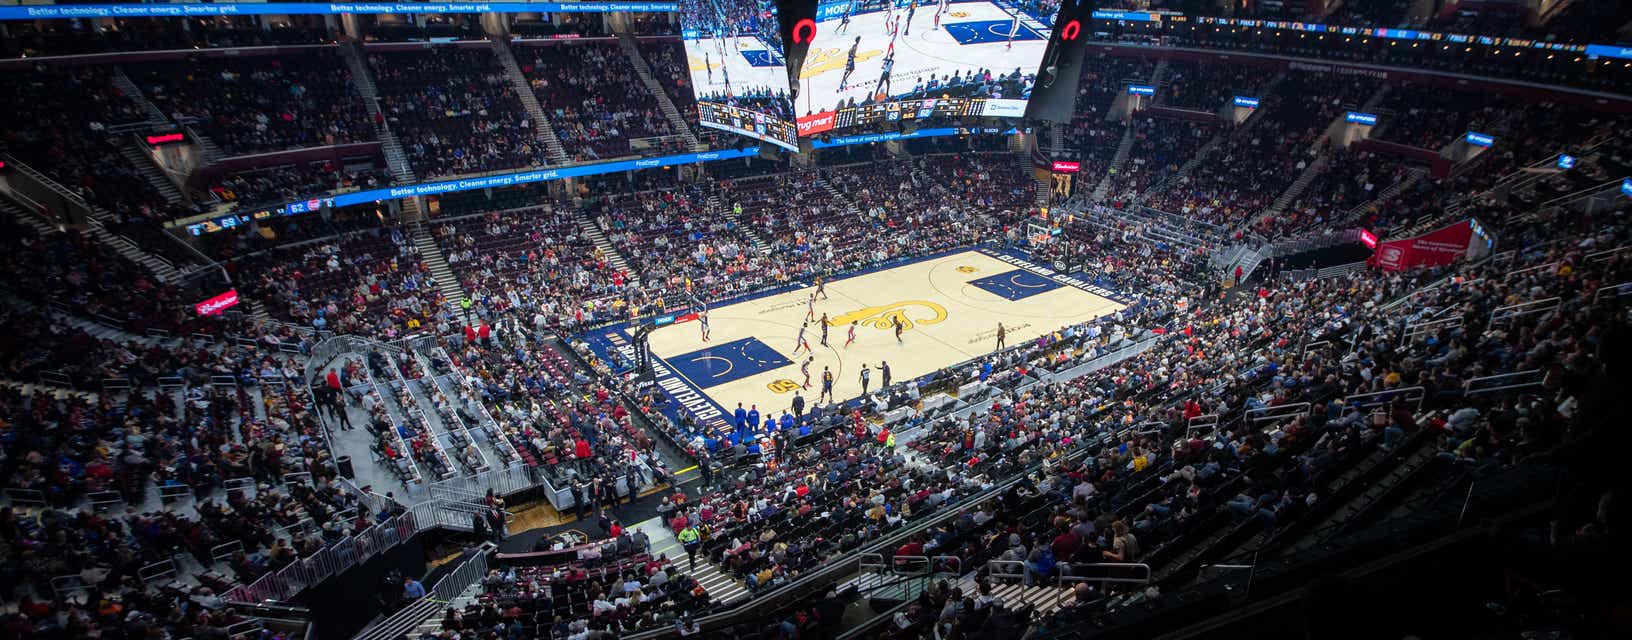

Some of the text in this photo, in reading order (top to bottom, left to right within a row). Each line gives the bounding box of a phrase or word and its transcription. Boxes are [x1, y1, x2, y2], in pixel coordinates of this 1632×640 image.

[28, 7, 58, 16] Better
[60, 7, 110, 16] technology.
[113, 6, 148, 14] Cleaner
[184, 5, 218, 14] Smarter
[797, 116, 832, 131] rug mart
[391, 170, 558, 197] Better technology. Cleaner energy. Smarter grid.
[291, 204, 304, 212] 62
[998, 254, 1055, 276] CLEVELAND
[1054, 274, 1114, 296] CAVALIERS
[617, 344, 671, 378] CAVAERS
[658, 377, 722, 420] CLEVELAND
